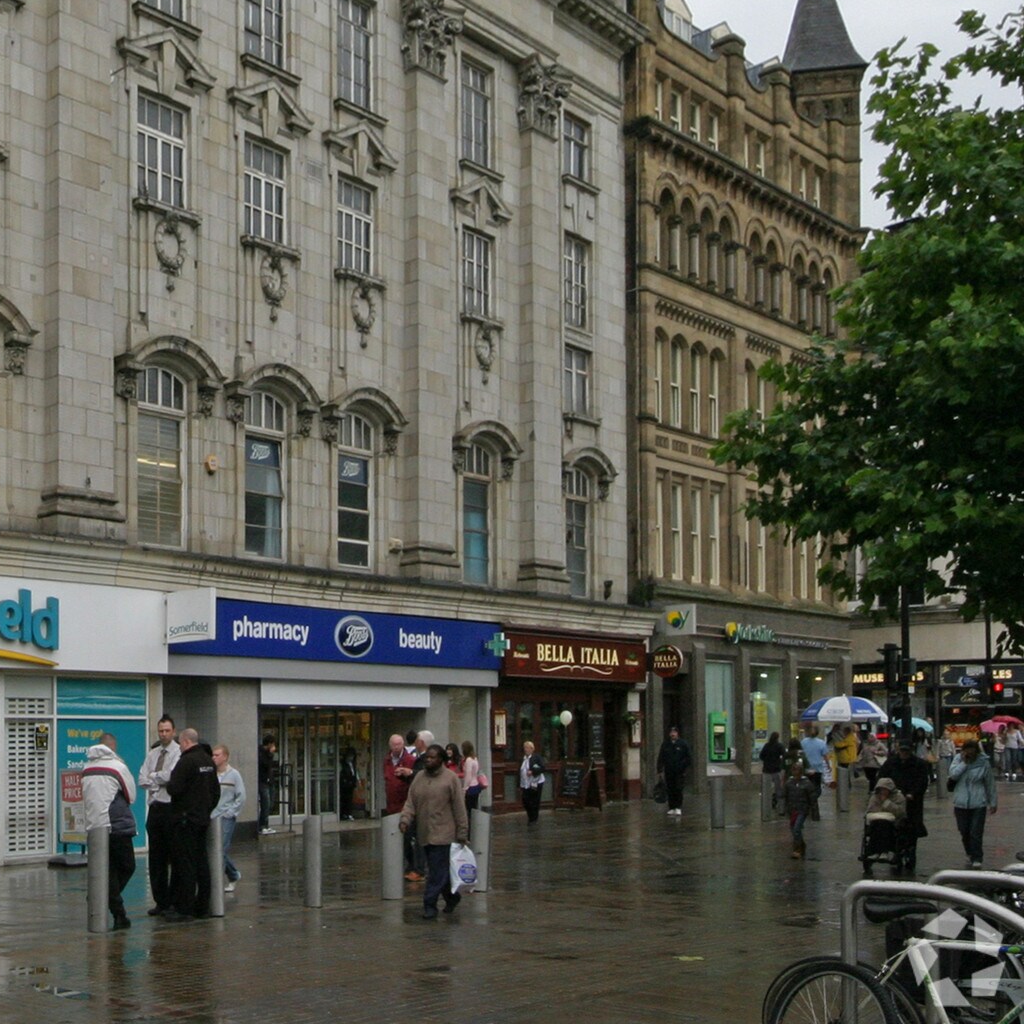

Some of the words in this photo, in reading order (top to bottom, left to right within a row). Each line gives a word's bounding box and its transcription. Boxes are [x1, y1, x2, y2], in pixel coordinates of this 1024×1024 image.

[169, 620, 209, 637] Somerfield
[233, 615, 310, 646] pharmacy
[342, 624, 369, 647] Boots
[399, 627, 442, 654] beauty
[537, 643, 575, 664] BELLA
[580, 647, 619, 667] ITALIA
[65, 775, 80, 787] HALF
[64, 788, 81, 799] PRICE
